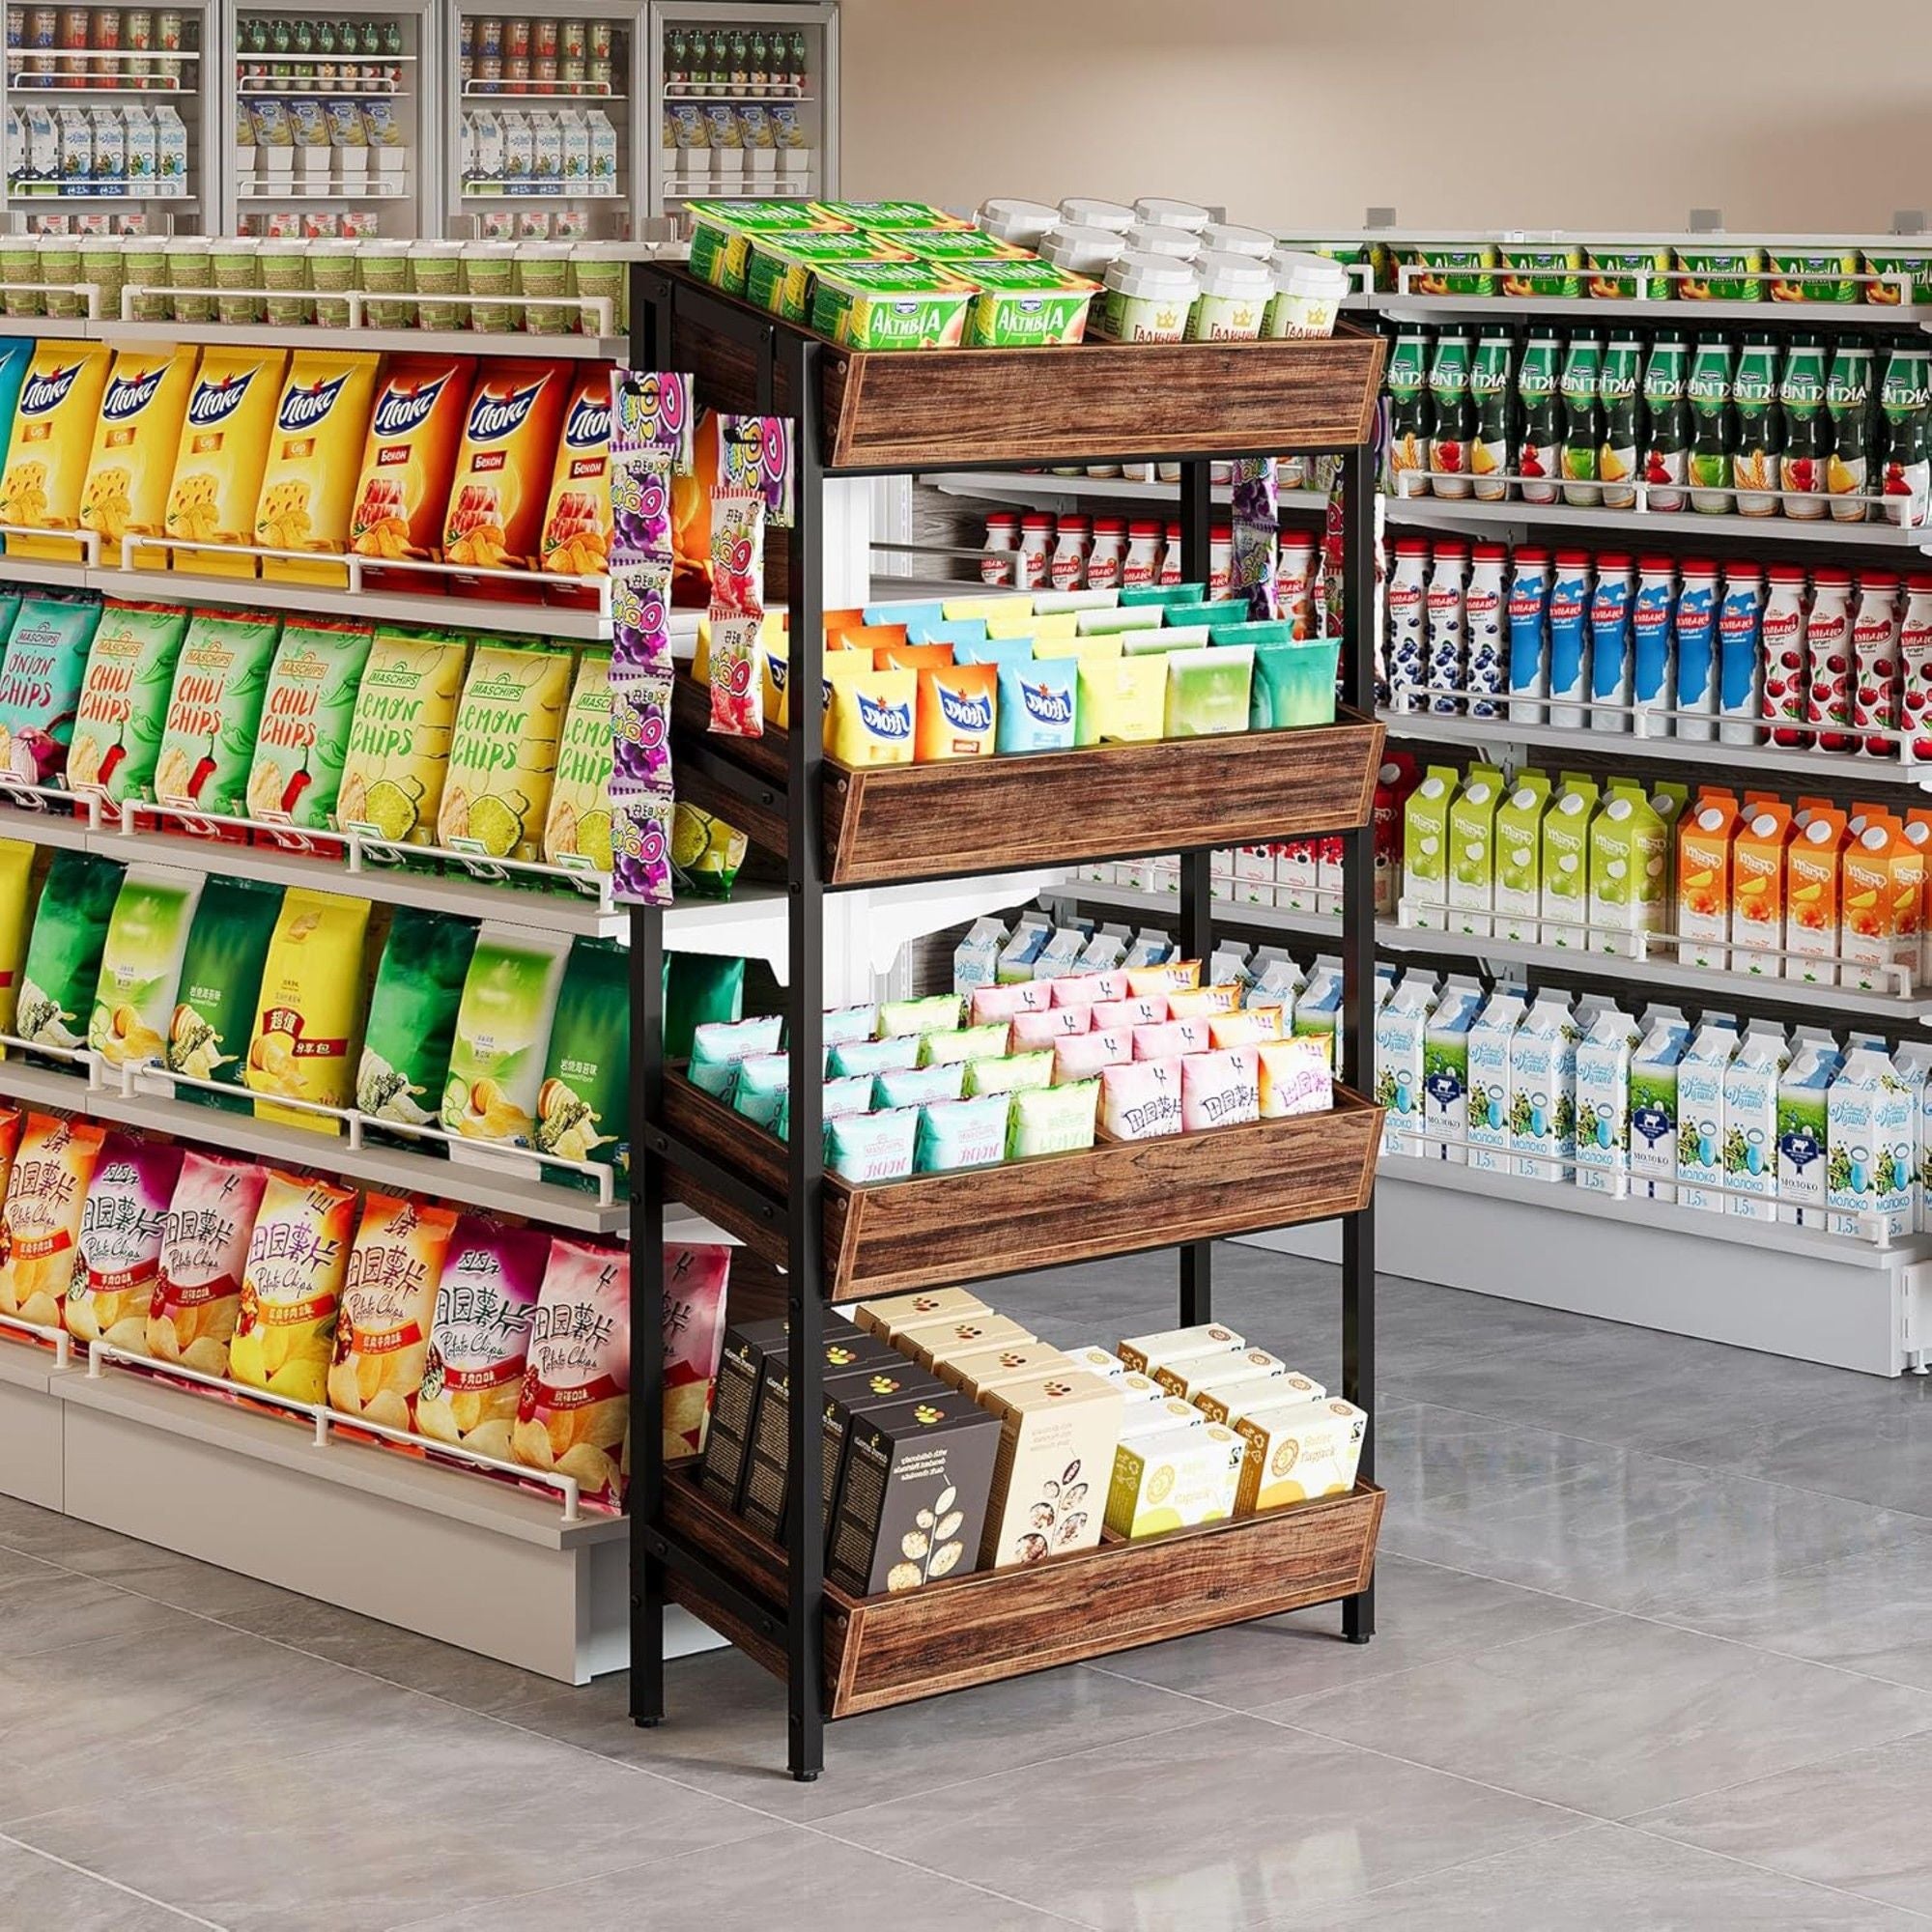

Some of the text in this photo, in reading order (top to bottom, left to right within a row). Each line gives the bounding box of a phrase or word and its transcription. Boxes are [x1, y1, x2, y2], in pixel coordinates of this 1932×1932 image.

[22, 374, 72, 408] Люкс
[104, 378, 156, 412] Люкс
[190, 383, 243, 417] Люкс
[281, 387, 336, 422] Люкс
[376, 391, 435, 429] Люкс
[469, 397, 526, 434] Люкс
[381, 449, 407, 462] Бекон
[475, 454, 502, 468] Бекон
[574, 461, 602, 474] Бекон
[18, 633, 59, 644] MASCHIPS
[99, 641, 142, 655] MASCHIPS
[9, 650, 56, 674] ONION
[186, 650, 233, 666] MASCHIPS
[280, 662, 326, 677] MASCHIPS
[90, 662, 135, 694] CHILI
[178, 673, 225, 703] CHILI
[370, 672, 418, 686] MASCHIPS
[270, 685, 318, 715] CHILI
[472, 684, 522, 698] MASCHIPS
[581, 696, 611, 709] MASC
[80, 691, 131, 723] CHIPS
[168, 702, 221, 735] CHIPS
[355, 692, 424, 722] LEMON
[459, 704, 527, 734] LEMON
[261, 715, 316, 747] CHIPS
[351, 721, 412, 758] CHIPS
[564, 717, 611, 747] LEMO
[452, 734, 519, 772] CHIPS
[559, 747, 611, 784] CHIP
[270, 1010, 297, 1035] 超值
[1469, 1131, 1504, 1146] МОЛОКО
[1512, 1139, 1547, 1153] МОЛОКО
[1577, 1151, 1612, 1165] МОЛОКО
[1679, 1170, 1716, 1183] МОЛОКО
[1726, 1178, 1764, 1192] МОЛОКО
[1830, 1196, 1868, 1209] МОЛОКО
[1876, 1196, 1909, 1209] МОЛОКО
